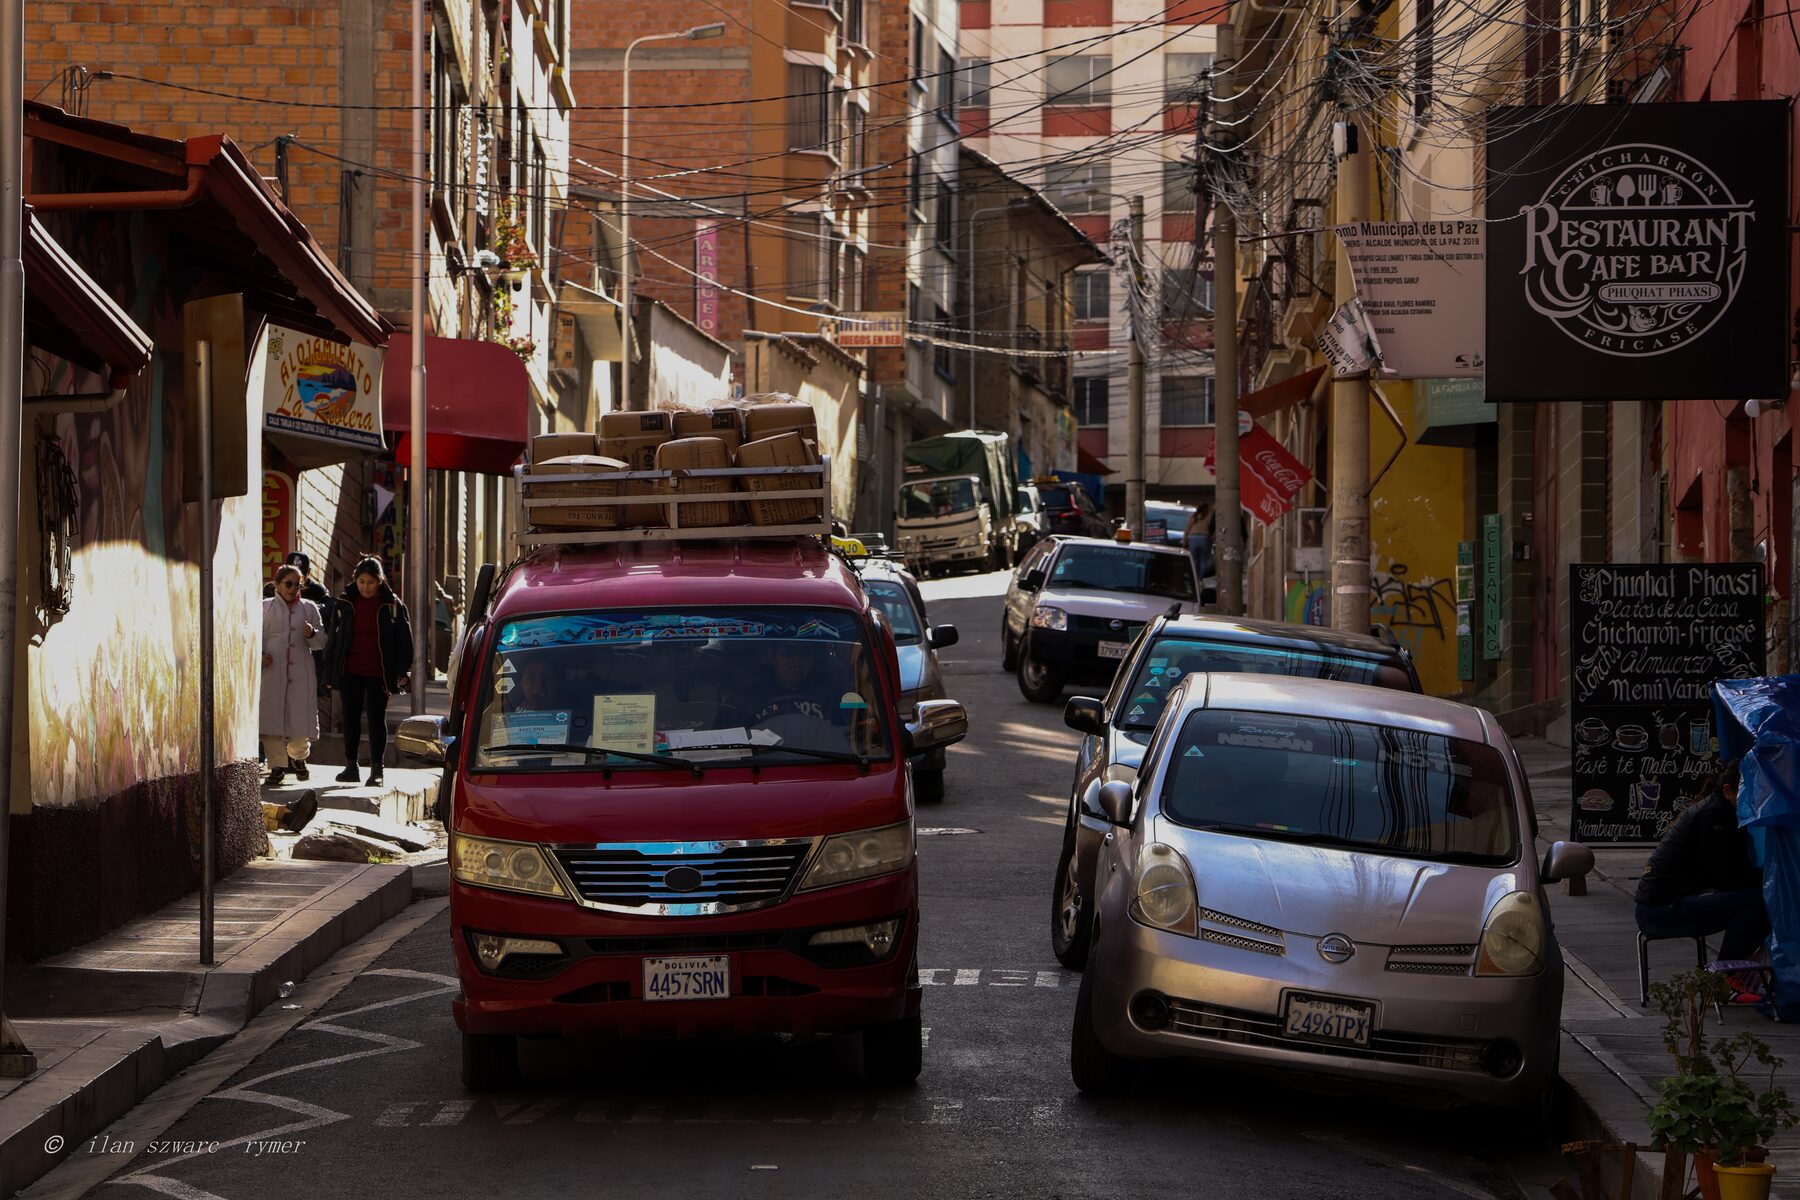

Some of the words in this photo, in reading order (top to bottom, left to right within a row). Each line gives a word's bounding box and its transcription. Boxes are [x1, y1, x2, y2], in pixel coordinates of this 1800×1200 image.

[1560, 152, 1718, 197] CHICHARRÓN
[1361, 222, 1418, 238] Municipal
[1423, 222, 1436, 235] de
[1441, 221, 1453, 234] La
[1458, 221, 1478, 234] Paz
[1394, 238, 1428, 246] MUNICIPAL
[1518, 202, 1756, 275] RESTAURANT
[1555, 250, 1640, 301] CAFE
[1650, 250, 1716, 278] BAR
[1607, 287, 1664, 298] PHUQHAT
[1669, 287, 1712, 297] PHAXSI
[1584, 321, 1699, 350] FRICASÉ
[280, 338, 372, 395] ALOJAMIENTO
[276, 384, 303, 418] La
[1487, 530, 1497, 651] CLEANING
[1594, 600, 1655, 622] Platos
[1697, 598, 1740, 618] Casa
[1576, 756, 1608, 779] Café
[1322, 943, 1352, 953] NISSAN
[664, 962, 708, 970] BOLIVIA
[650, 971, 724, 996] 4457SRN
[1290, 1009, 1367, 1041] 2496TPX
